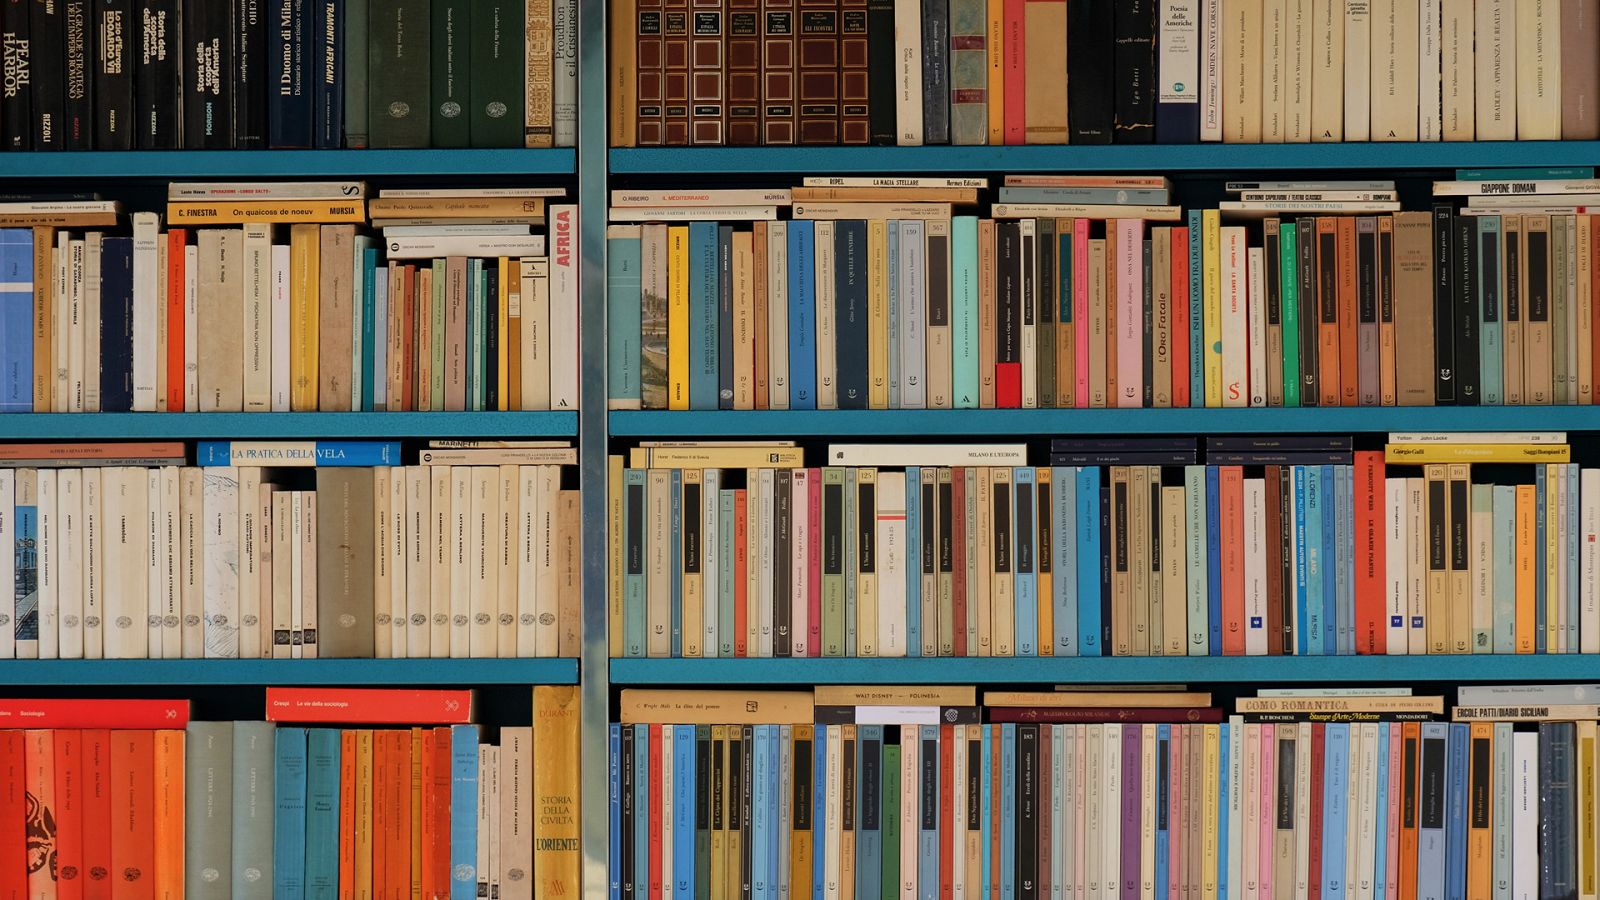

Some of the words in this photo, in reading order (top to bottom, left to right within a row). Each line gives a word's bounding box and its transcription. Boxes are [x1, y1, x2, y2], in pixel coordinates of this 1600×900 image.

[75, 2, 82, 13] LA
[115, 11, 122, 21] Lo
[281, 30, 291, 40] di
[554, 6, 564, 60] Proudhon
[4, 33, 15, 97] HARBOR
[16, 40, 29, 89] PEARL
[203, 47, 212, 86] scoperta
[281, 44, 291, 83] Duomo
[75, 53, 83, 99] STRATEGIA
[42, 114, 51, 142] RIZZOLI
[1481, 184, 1509, 193] GIAPPONE
[1512, 183, 1536, 193] DOMANI
[557, 211, 570, 266] AFRICA
[1193, 303, 1199, 315] UN
[232, 449, 243, 458] LA
[246, 449, 283, 458] PRATICA
[286, 449, 315, 458] DELLA
[317, 449, 345, 458] VELA
[1246, 701, 1277, 710] COMO
[1281, 701, 1348, 710] ROMANTICA
[1457, 708, 1477, 717] ERCOLE
[1479, 708, 1519, 717] PATTI/DIARIO
[1520, 708, 1549, 717] SICILIANO
[544, 806, 569, 814] DELLA
[536, 838, 578, 851] L'ORIENTE
